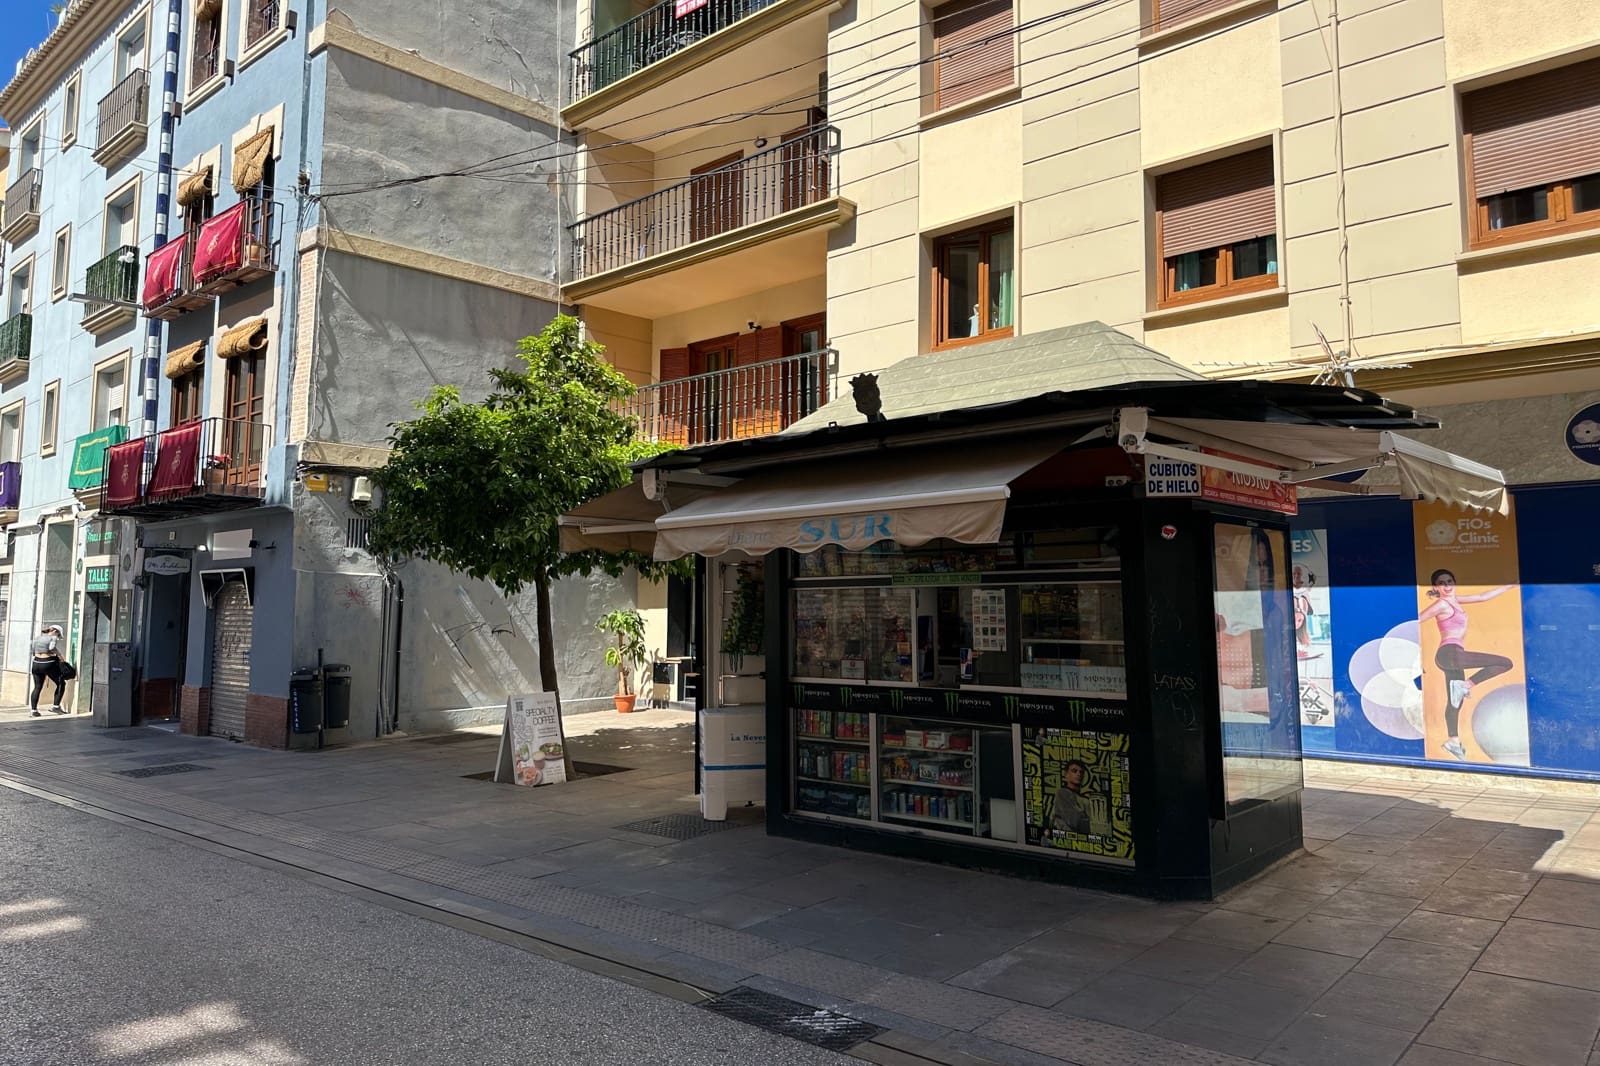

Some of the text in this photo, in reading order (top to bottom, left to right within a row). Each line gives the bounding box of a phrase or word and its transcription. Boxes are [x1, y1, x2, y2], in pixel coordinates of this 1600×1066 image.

[1149, 463, 1197, 477] CUBITOS
[1148, 480, 1199, 493] DE HIELO
[799, 514, 892, 543] SUR
[1457, 518, 1491, 530] FiOs
[1457, 533, 1499, 544] Clinic
[1291, 539, 1313, 553] ES
[525, 706, 556, 718] SPECIALTY
[1085, 707, 1125, 717] MONSTER
[532, 715, 556, 726] COFFEE
